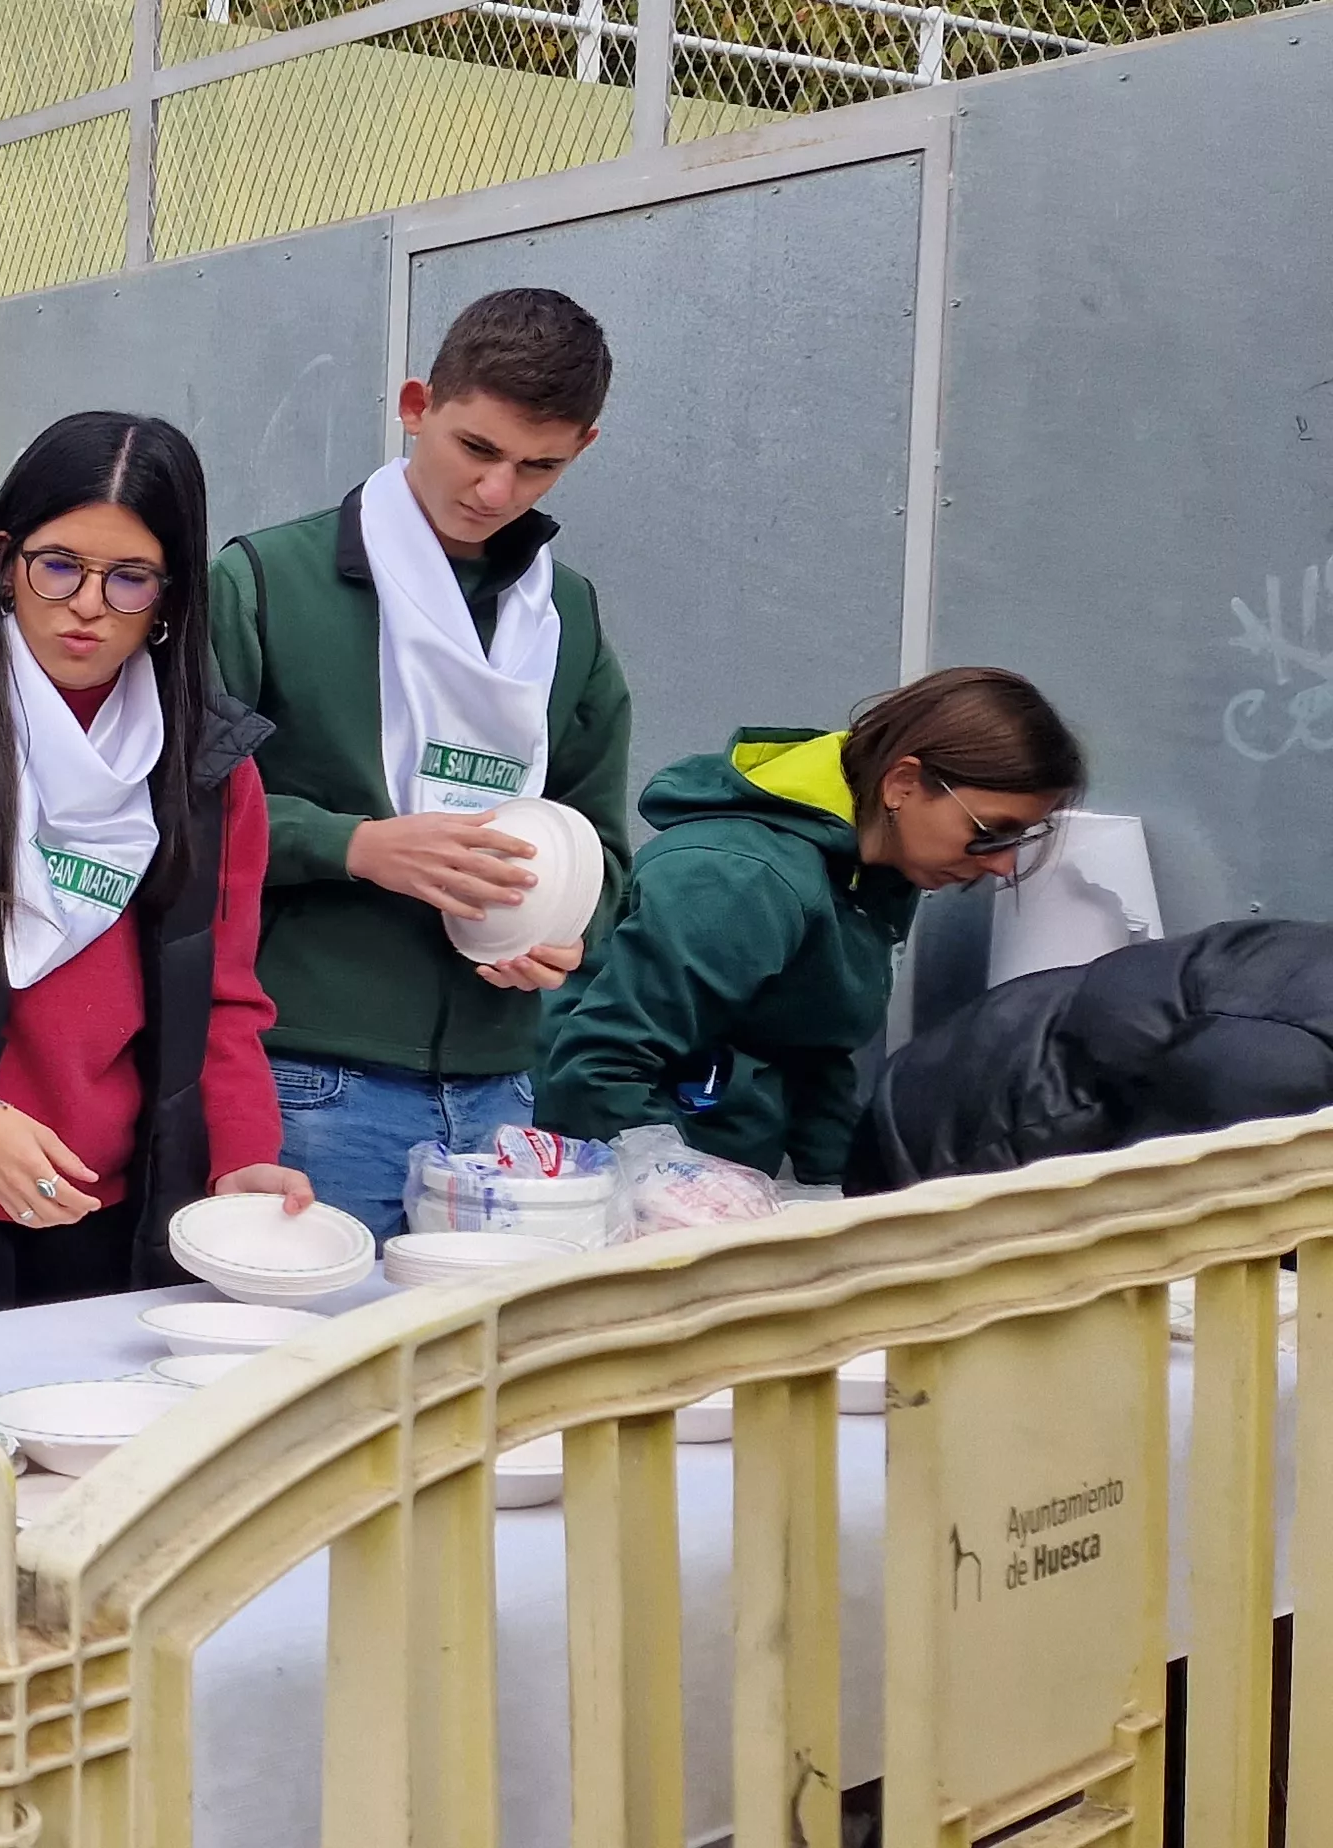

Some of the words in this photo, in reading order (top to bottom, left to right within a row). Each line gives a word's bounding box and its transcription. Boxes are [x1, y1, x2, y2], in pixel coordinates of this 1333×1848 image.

[445, 751, 474, 780] SAN
[473, 757, 525, 790] MARTIN
[48, 855, 77, 887] SAN
[77, 863, 133, 905] MARTIN
[1006, 1478, 1124, 1548] Ayuntamiento
[1006, 1552, 1028, 1590] de
[1033, 1533, 1101, 1581] Huesca
